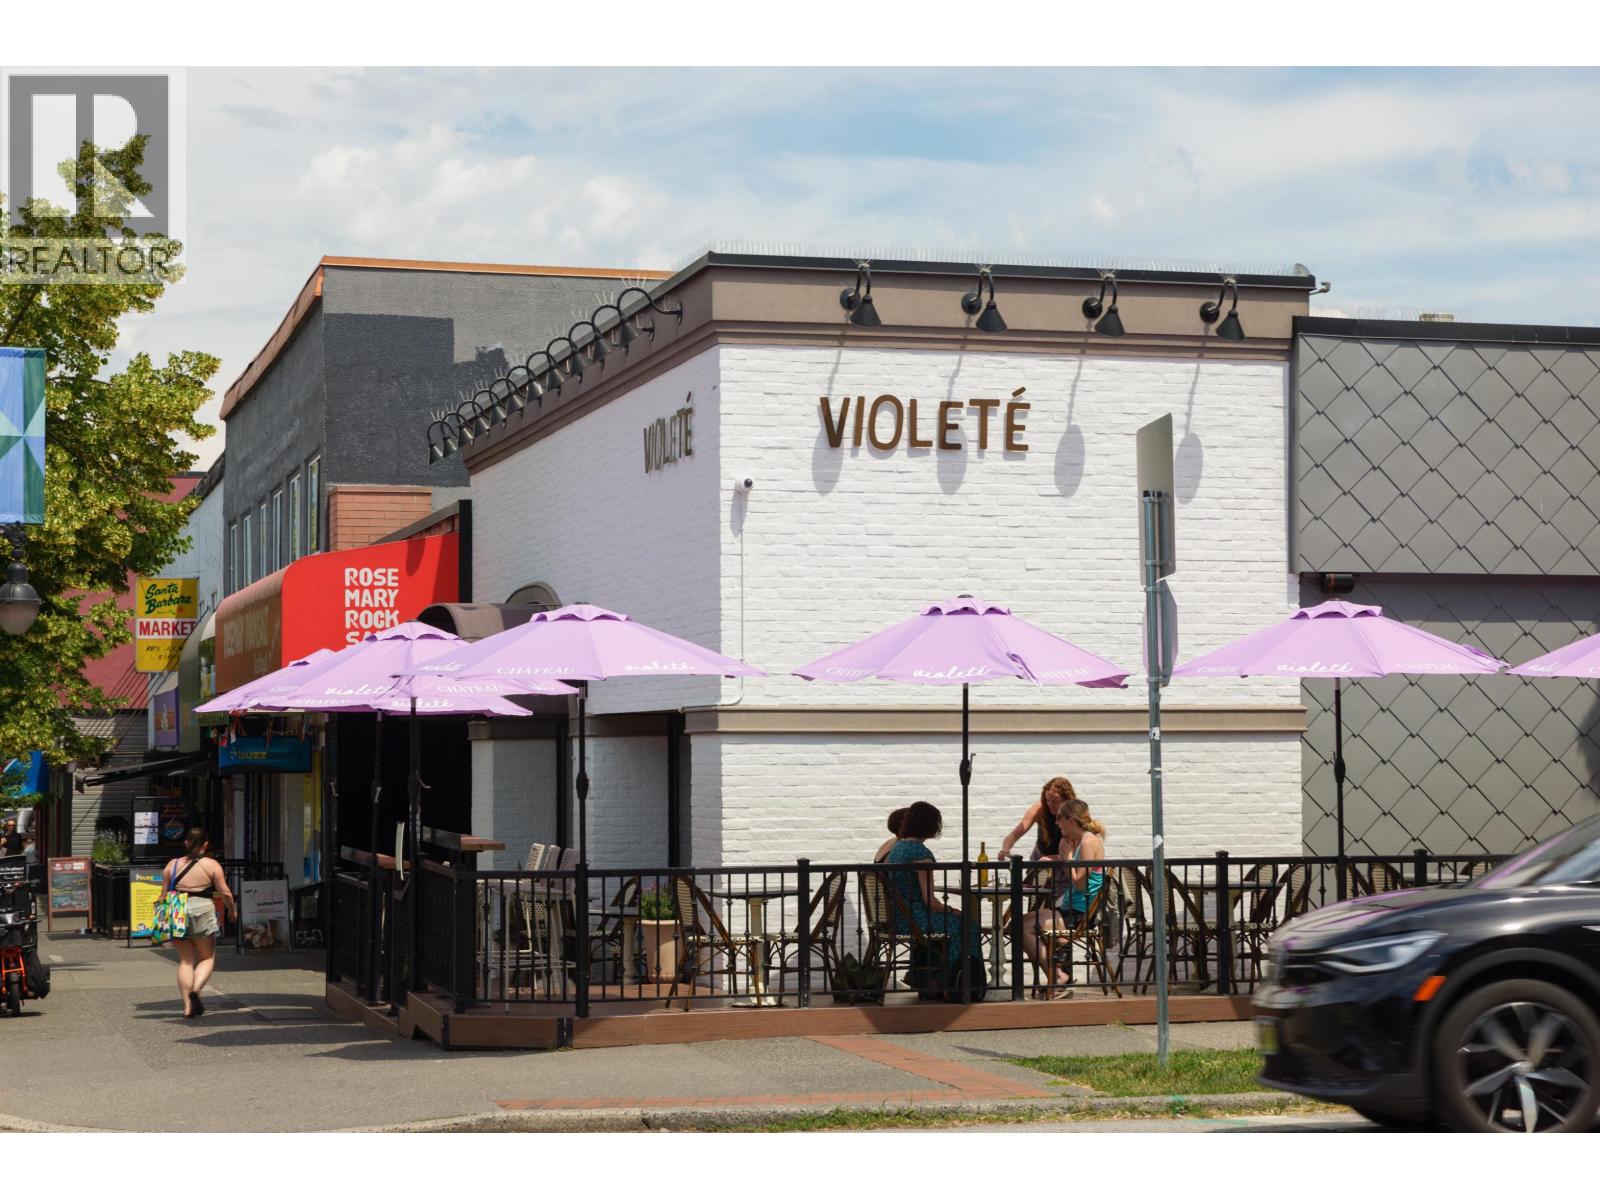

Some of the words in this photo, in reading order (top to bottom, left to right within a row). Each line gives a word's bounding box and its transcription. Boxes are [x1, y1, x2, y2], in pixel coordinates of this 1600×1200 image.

[819, 387, 1031, 452] VIOLETÉ
[643, 391, 693, 474] VIOLETÉ
[344, 567, 399, 587] ROSE
[145, 583, 179, 600] Santa
[344, 588, 399, 608] MARY
[139, 621, 197, 637] MARKET
[345, 609, 400, 629] ROCK
